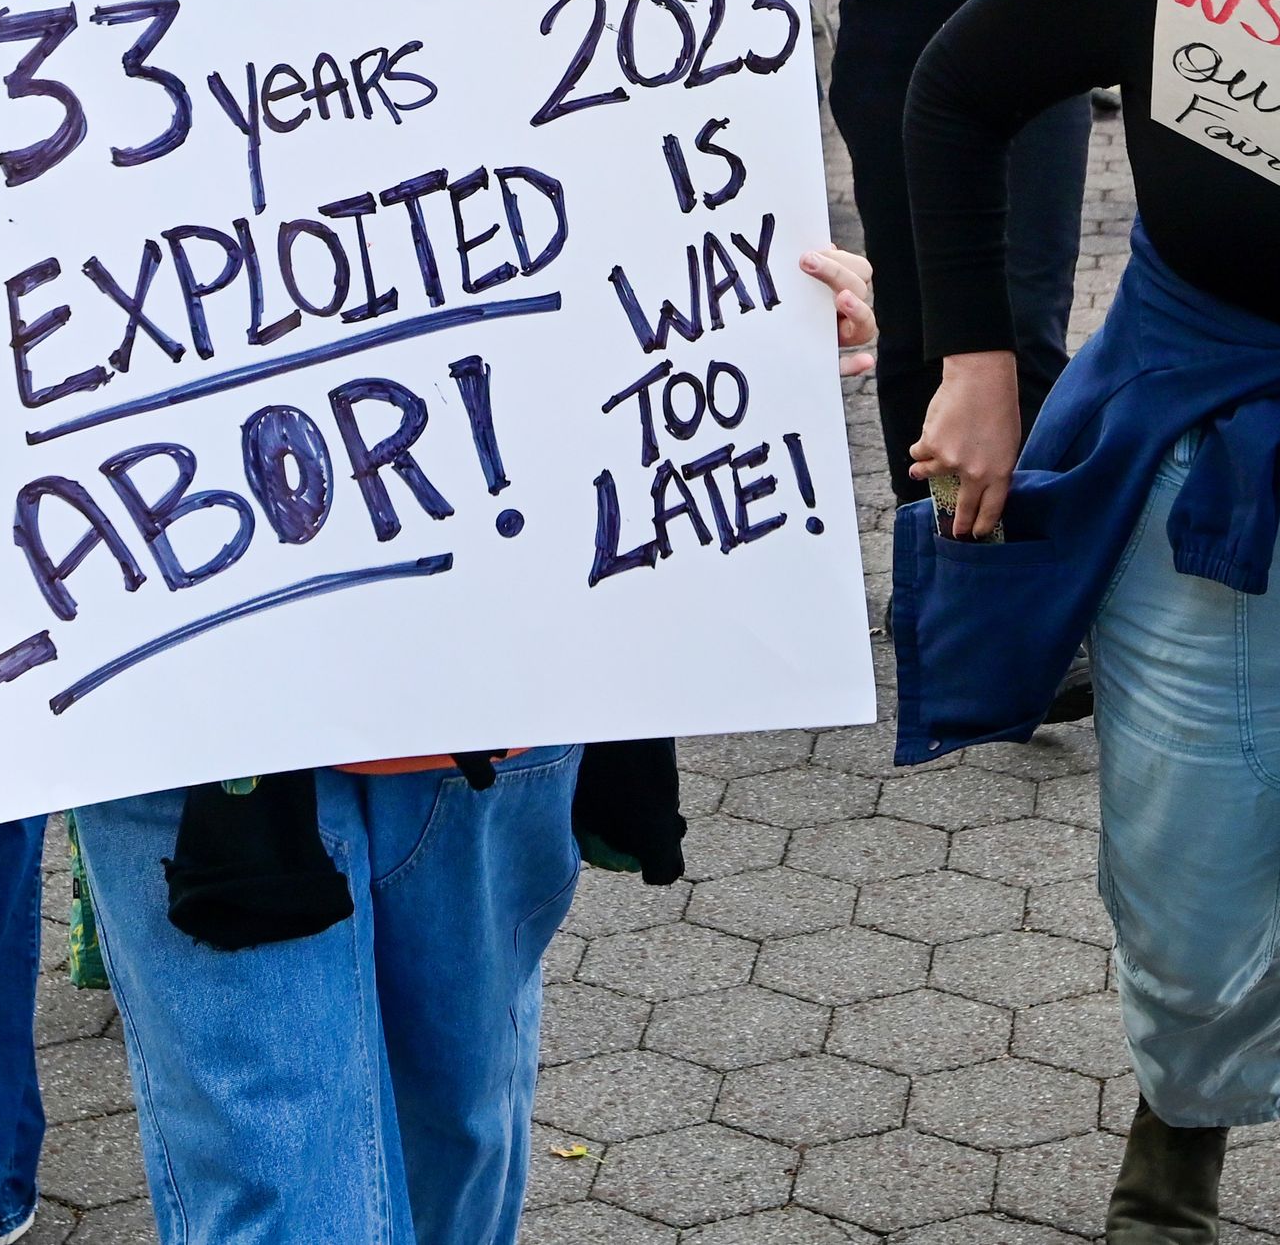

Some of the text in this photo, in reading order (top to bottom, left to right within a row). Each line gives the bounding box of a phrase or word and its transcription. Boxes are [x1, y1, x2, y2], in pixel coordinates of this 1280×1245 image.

[661, 116, 750, 215] IS
[4, 163, 571, 410] EXPLOITED
[607, 213, 780, 355] WAY
[601, 358, 750, 467] TOO
[587, 431, 828, 589] LATE!
